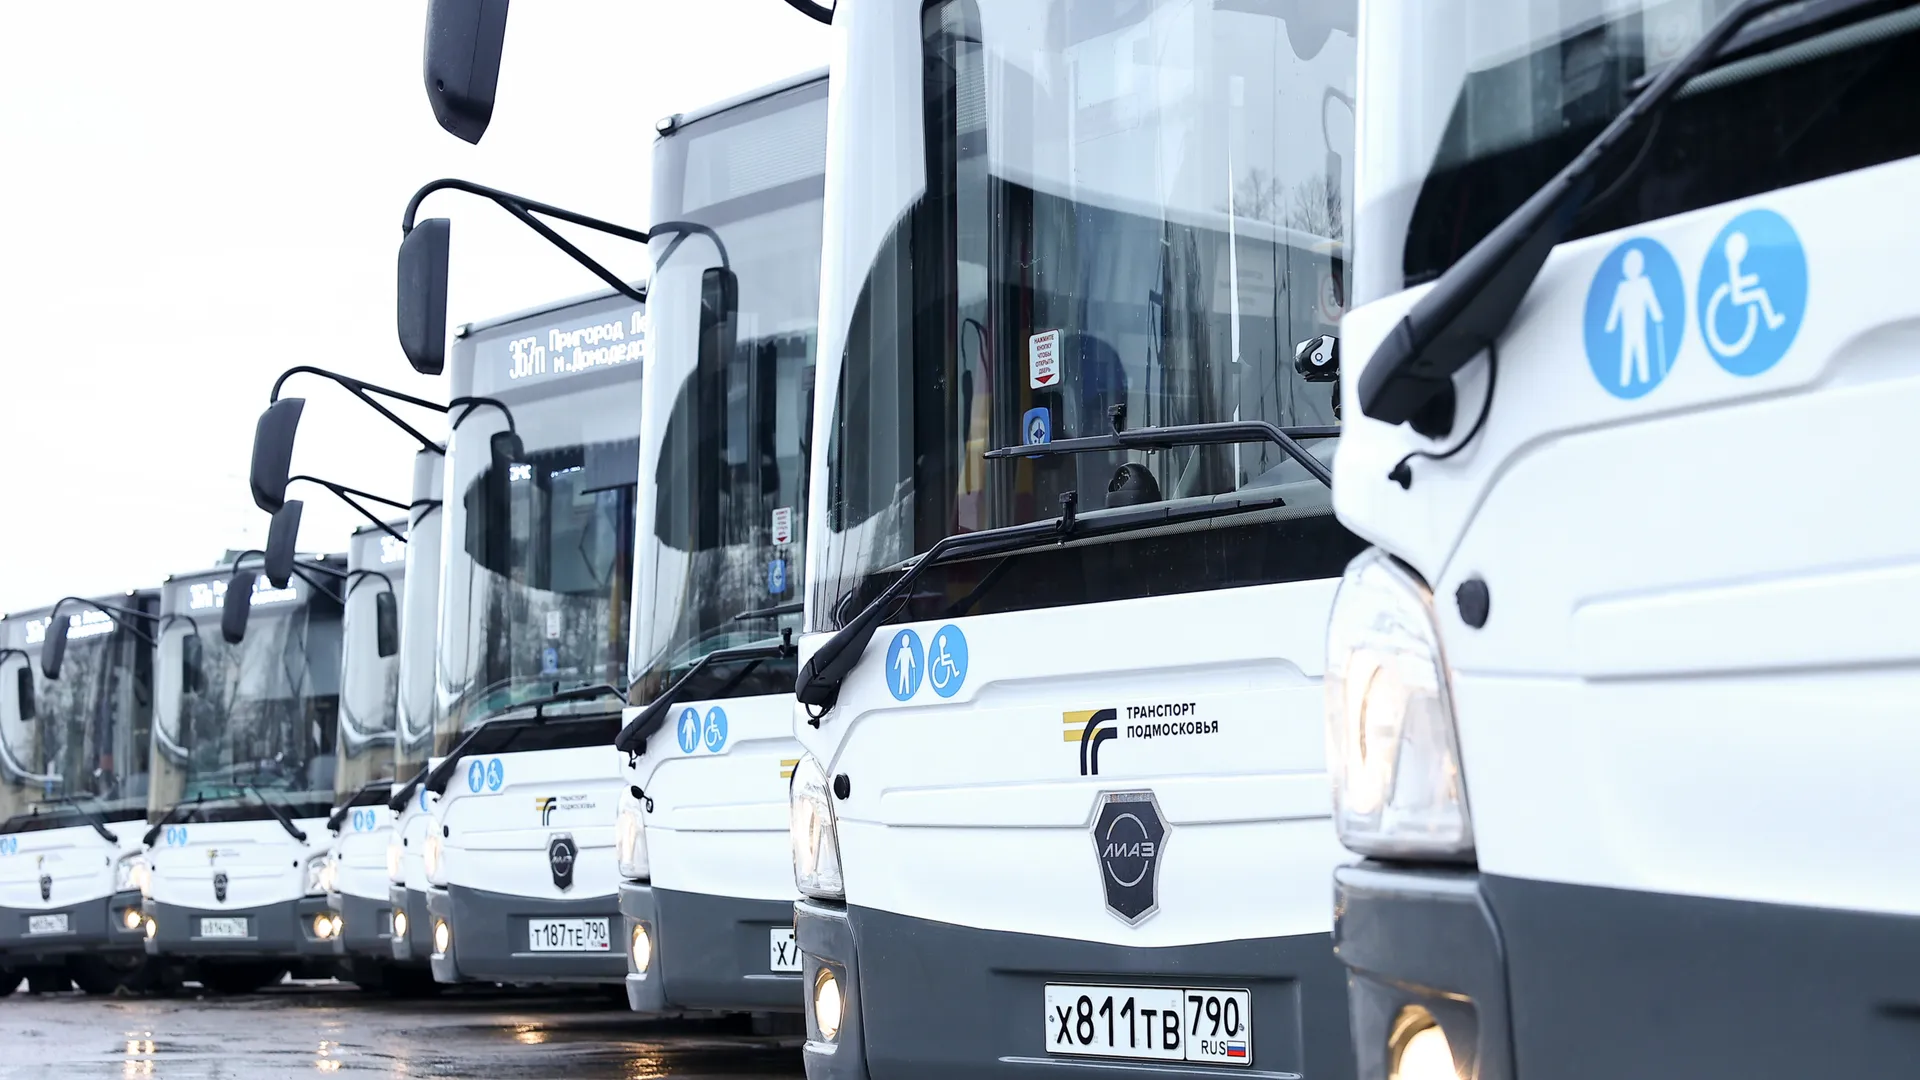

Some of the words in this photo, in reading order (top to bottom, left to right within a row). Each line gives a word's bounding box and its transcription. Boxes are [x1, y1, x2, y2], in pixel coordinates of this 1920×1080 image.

[1035, 334, 1054, 343] НАЖМИТЕ
[1037, 343, 1052, 351] КНОПКУ
[509, 336, 546, 379] 367п
[549, 321, 624, 352] Пригород
[1035, 358, 1054, 367] ОТКРЫТЬ
[1126, 702, 1196, 720] ТРАНСПОРТ
[1126, 720, 1219, 739] ПОДМОСКОВЬЯ
[1102, 842, 1155, 858] ЛИАЗ
[534, 924, 583, 947] Т187ТЕ
[585, 922, 606, 939] 790
[1055, 995, 1181, 1050] Х811ТВ
[1188, 995, 1240, 1036] 790
[1200, 1040, 1226, 1056] RUS
